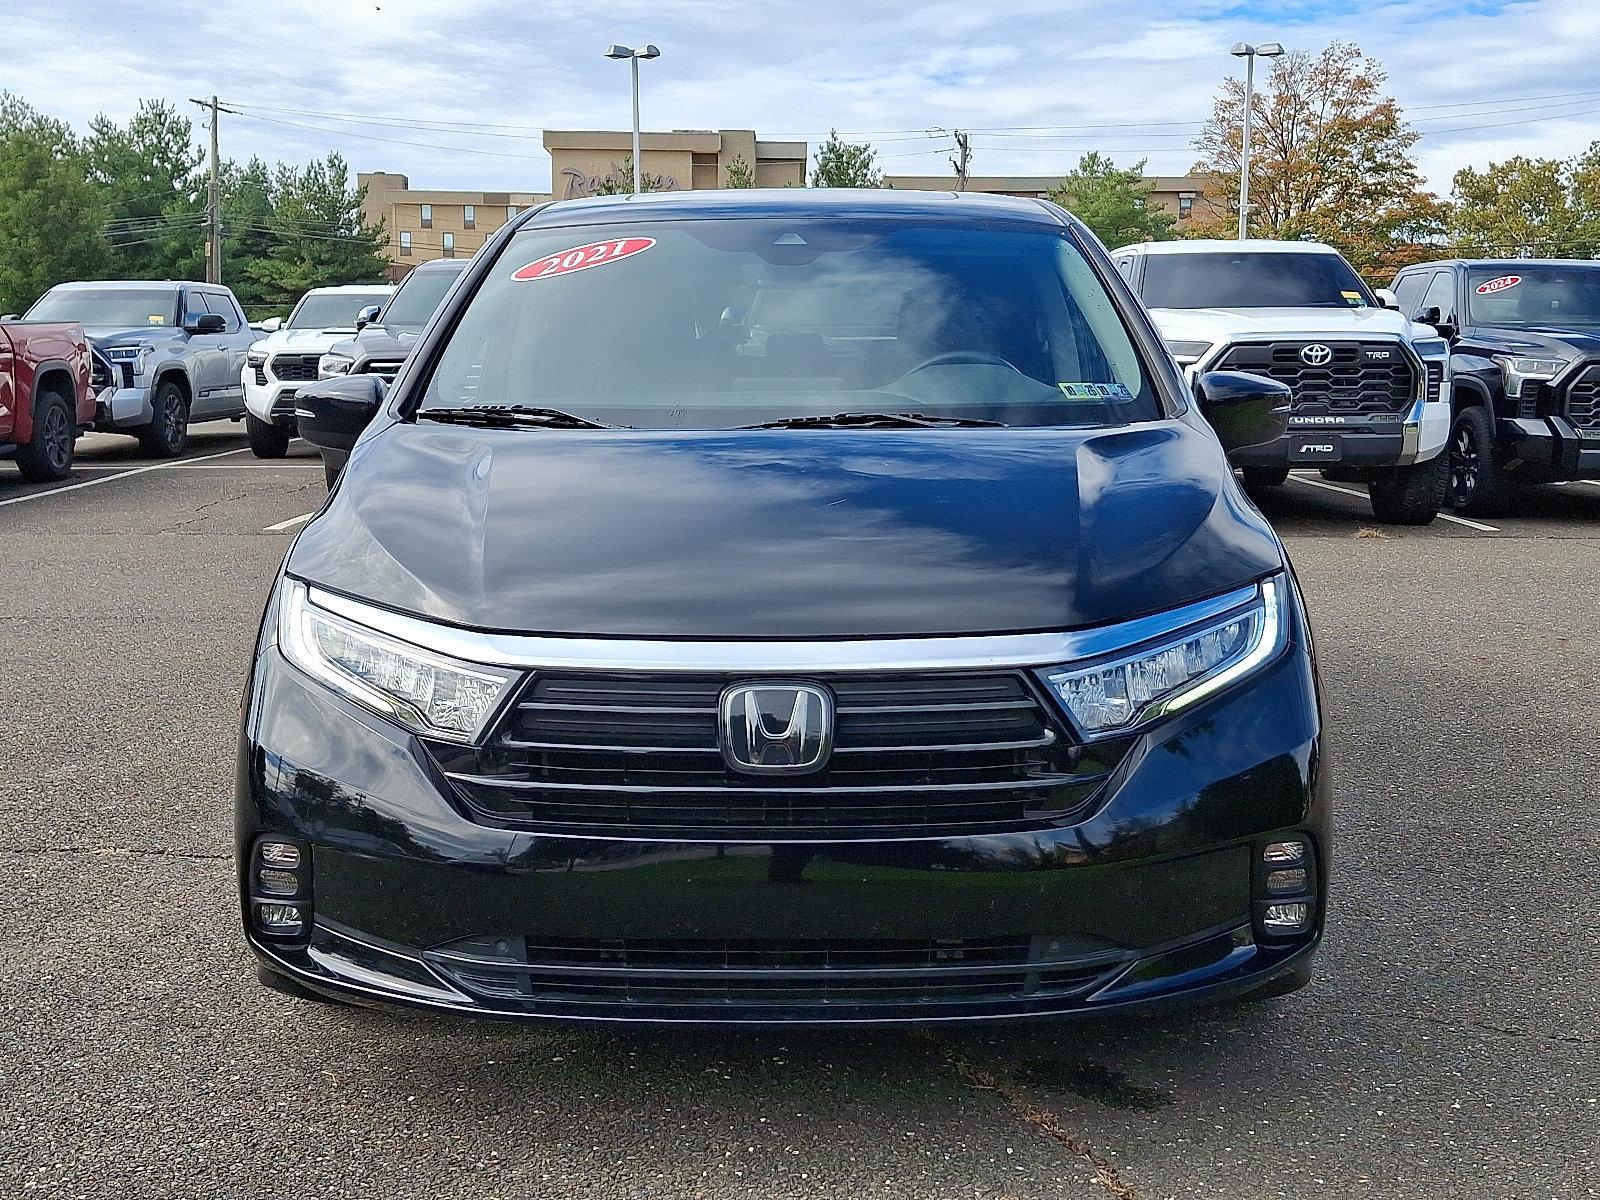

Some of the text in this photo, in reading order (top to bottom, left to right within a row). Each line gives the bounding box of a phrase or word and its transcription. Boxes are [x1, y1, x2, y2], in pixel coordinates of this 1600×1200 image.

[537, 240, 627, 277] 2021
[1484, 277, 1512, 292] 2024
[1365, 351, 1390, 360] TRD
